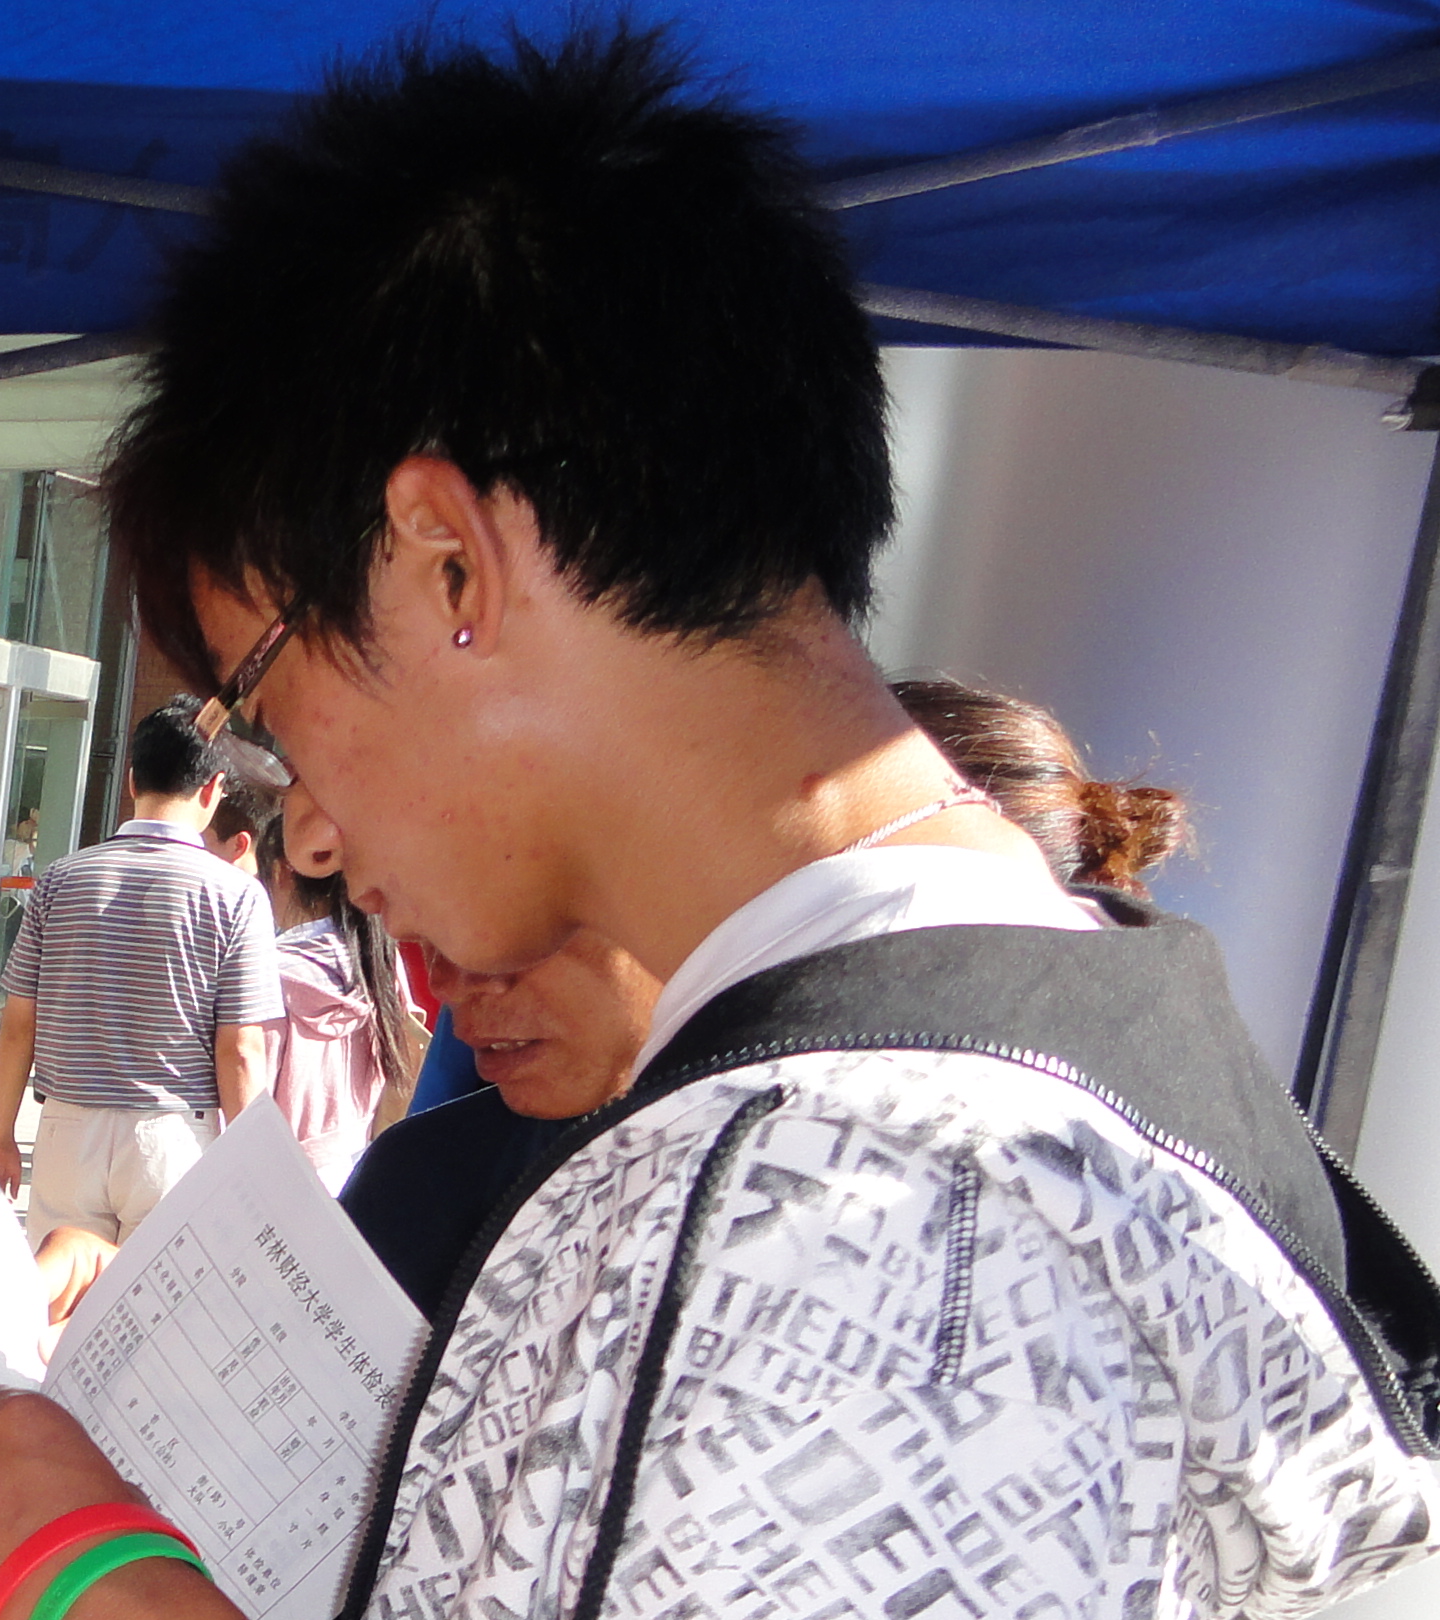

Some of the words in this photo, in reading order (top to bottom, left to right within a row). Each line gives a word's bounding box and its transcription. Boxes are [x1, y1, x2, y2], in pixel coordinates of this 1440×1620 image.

[248, 1221, 402, 1412] 吉林财经大学学生体检表
